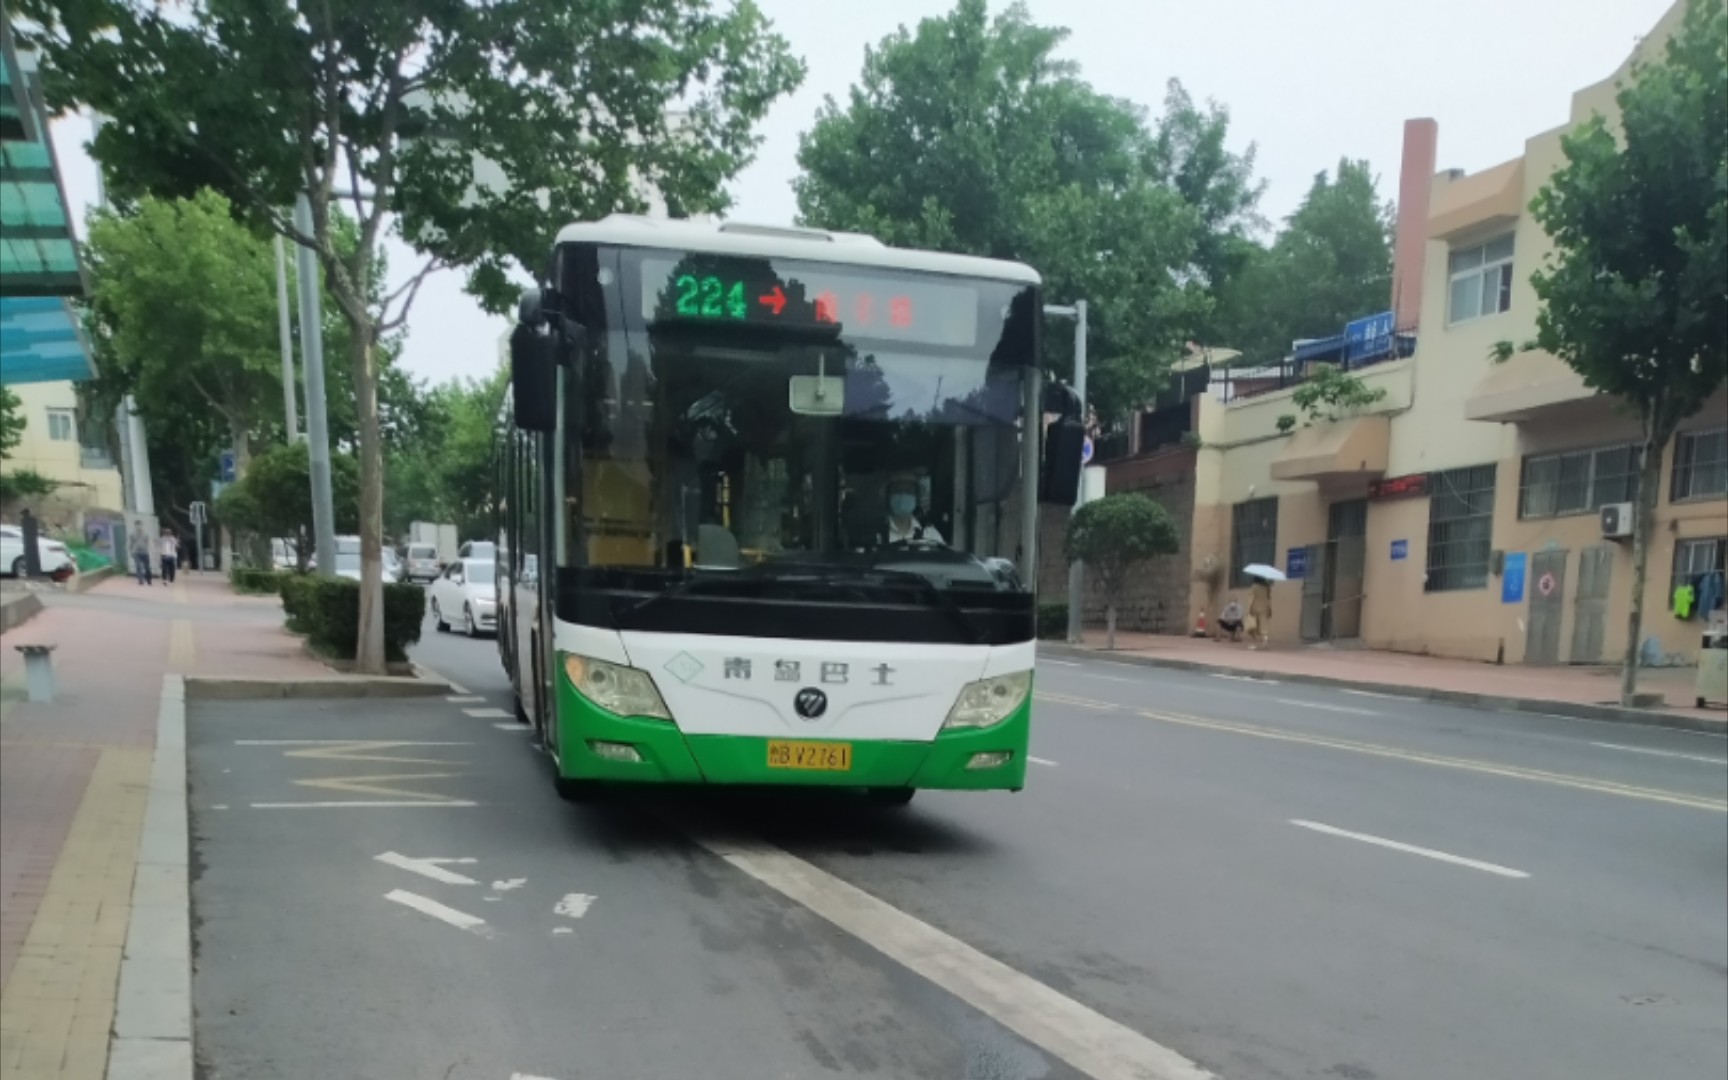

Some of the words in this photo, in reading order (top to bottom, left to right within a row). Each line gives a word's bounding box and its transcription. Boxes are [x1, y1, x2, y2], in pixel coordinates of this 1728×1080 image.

[675, 275, 747, 318] 224
[724, 657, 896, 686] 青岛巴士
